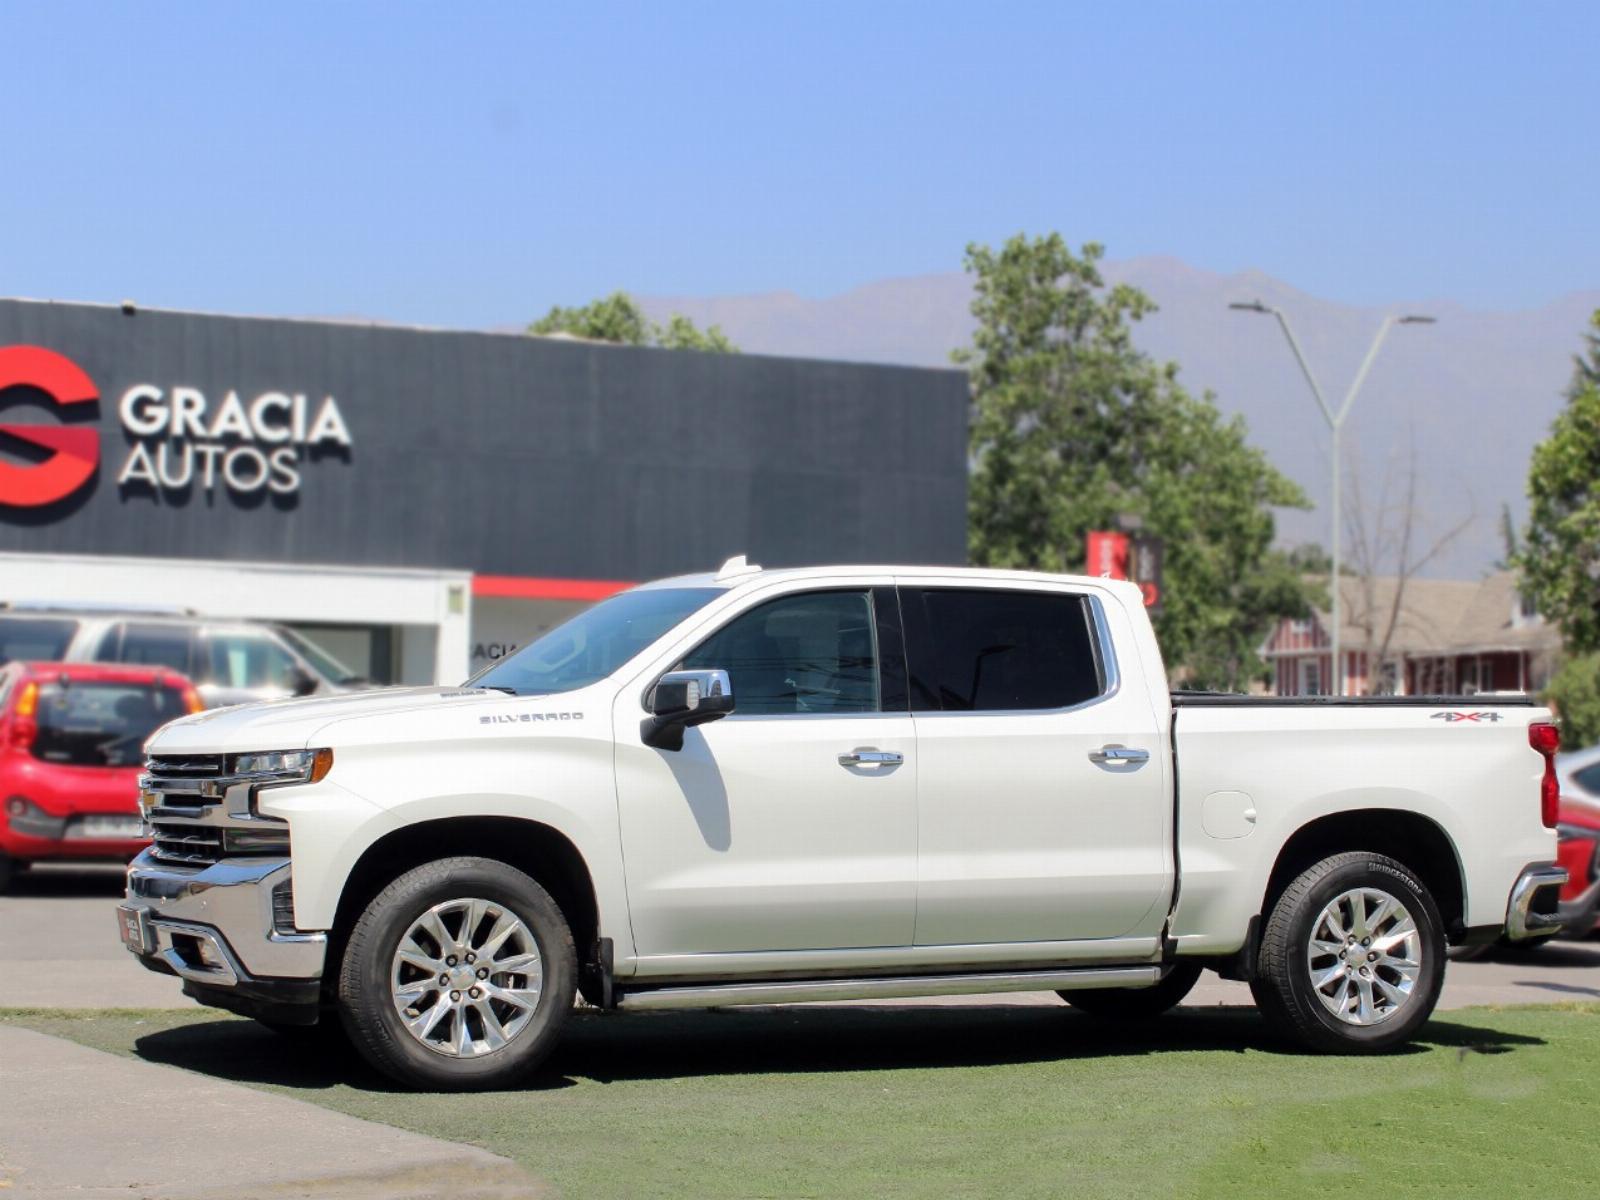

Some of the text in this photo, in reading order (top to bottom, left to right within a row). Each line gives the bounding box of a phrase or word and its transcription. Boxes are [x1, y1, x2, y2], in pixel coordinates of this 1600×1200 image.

[119, 384, 352, 445] GRACIA
[118, 442, 302, 493] AUTOS
[479, 712, 584, 725] SILVERADO
